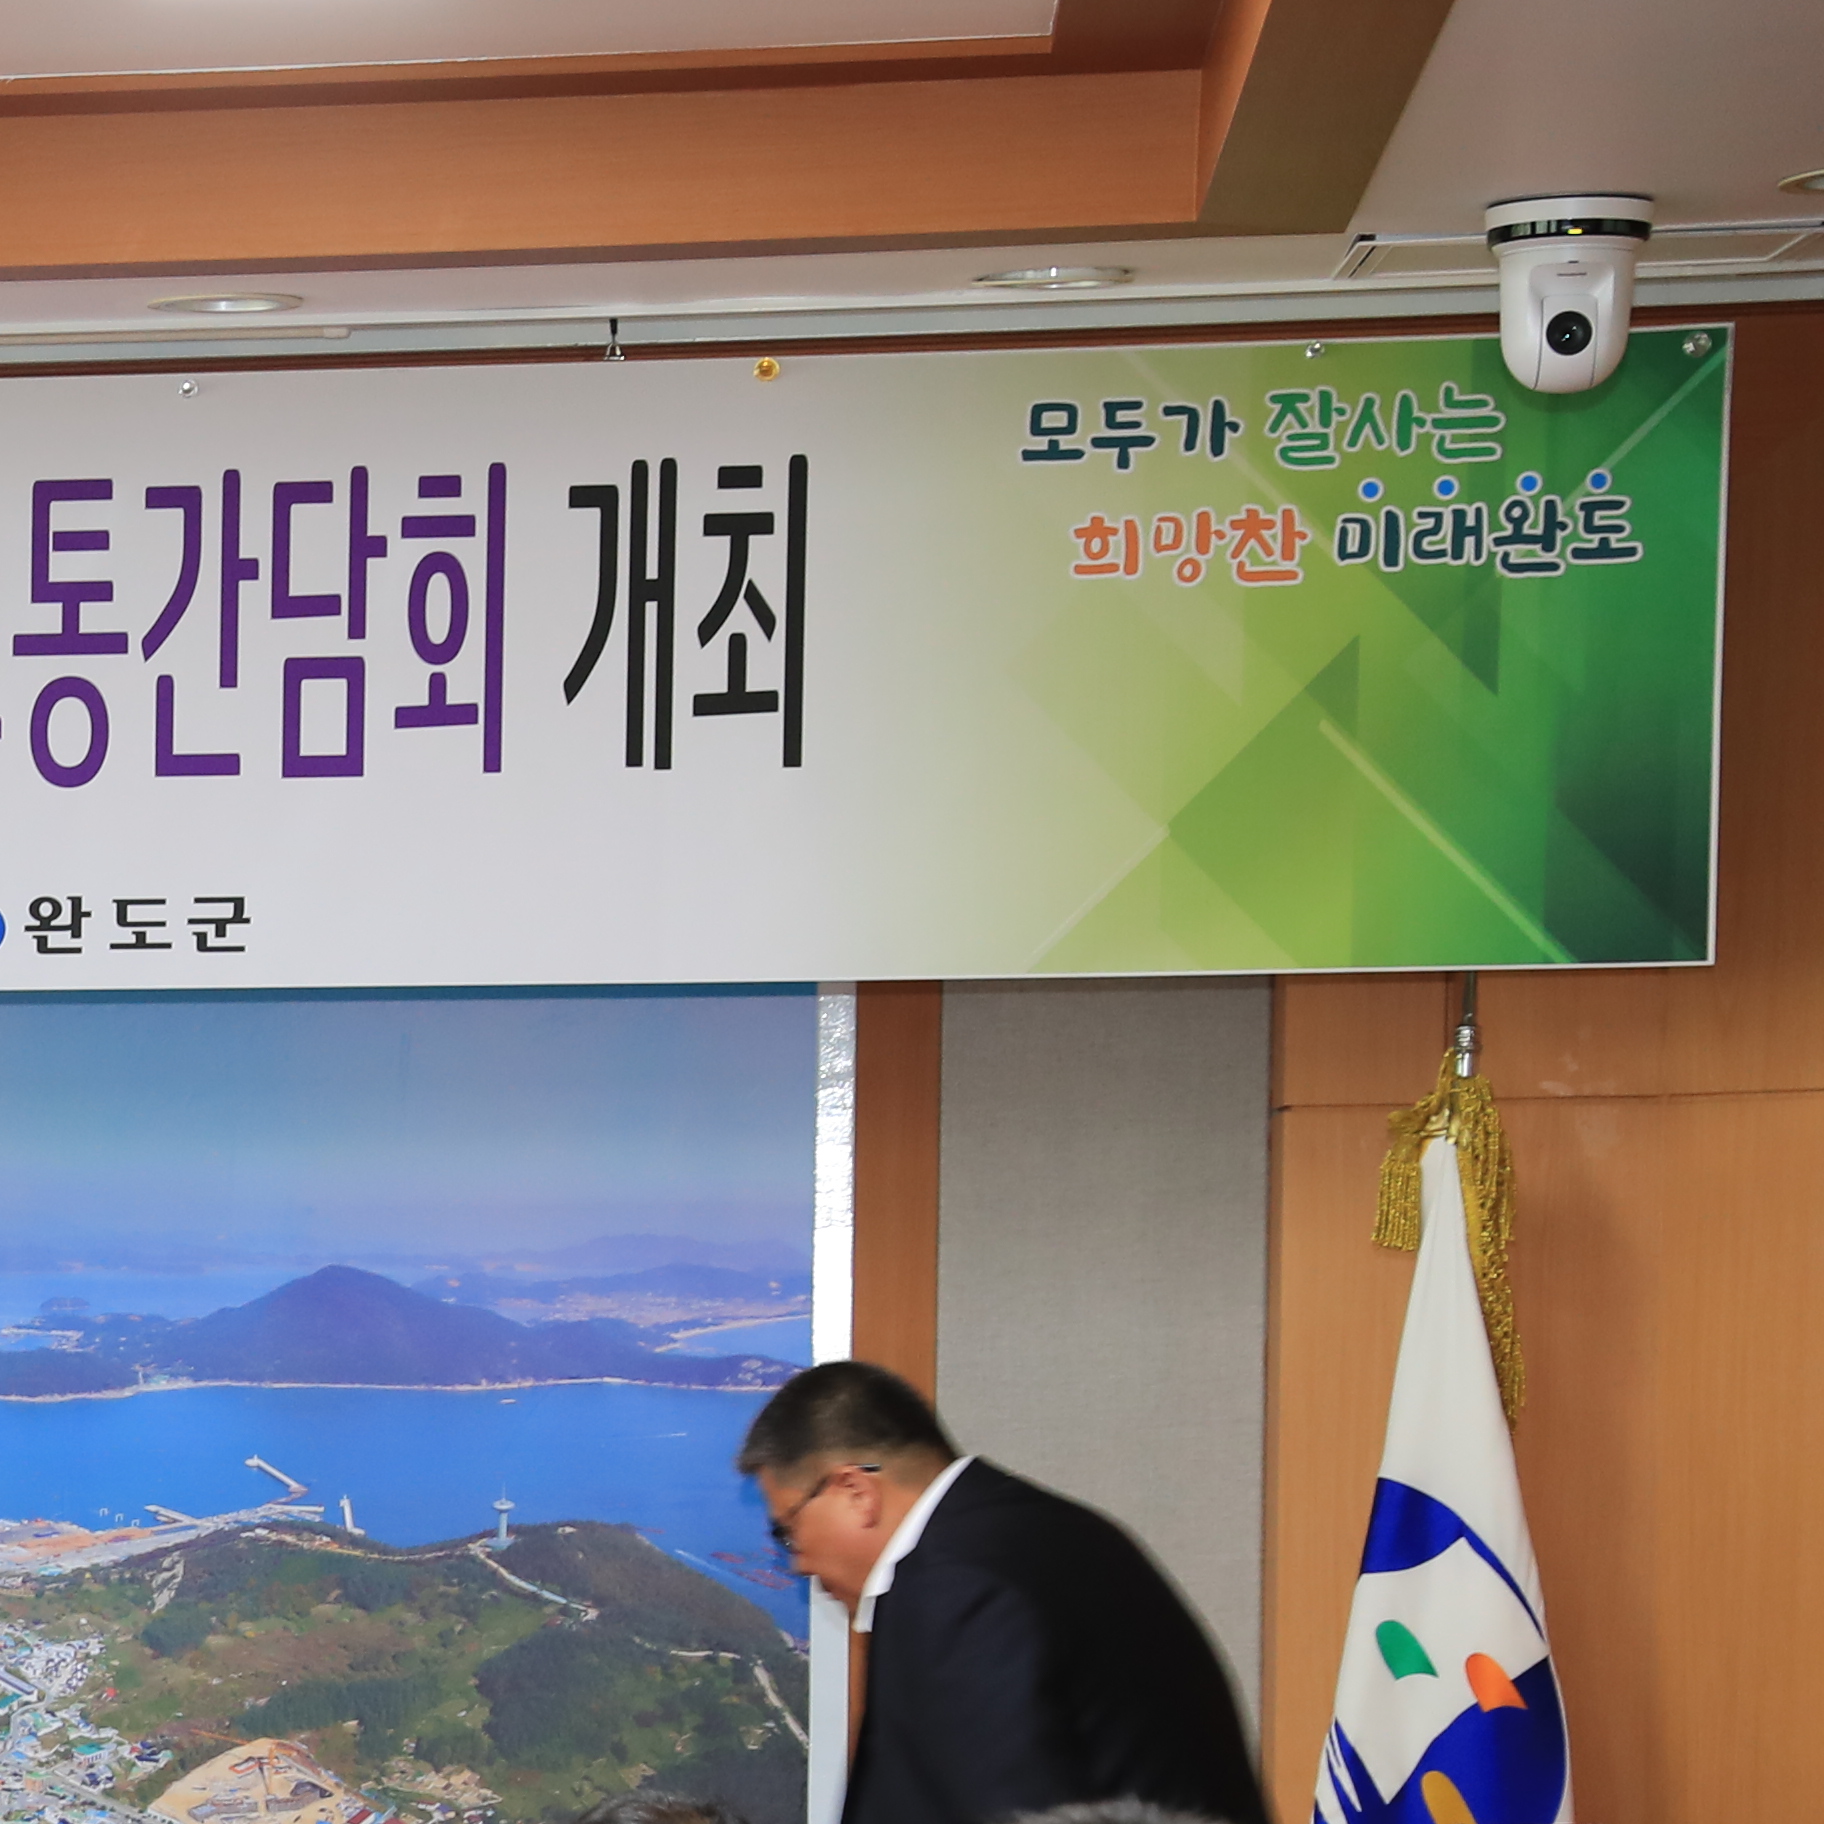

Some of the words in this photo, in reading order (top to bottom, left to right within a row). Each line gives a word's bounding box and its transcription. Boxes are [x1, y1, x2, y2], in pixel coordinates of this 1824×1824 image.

[1021, 397, 1241, 471] 모두가
[1265, 384, 1503, 467] 잘사는
[1071, 505, 1309, 584] 희망찬
[1336, 497, 1641, 574] 미래완도
[563, 453, 809, 771] 개최
[24, 896, 251, 954] 완도군
